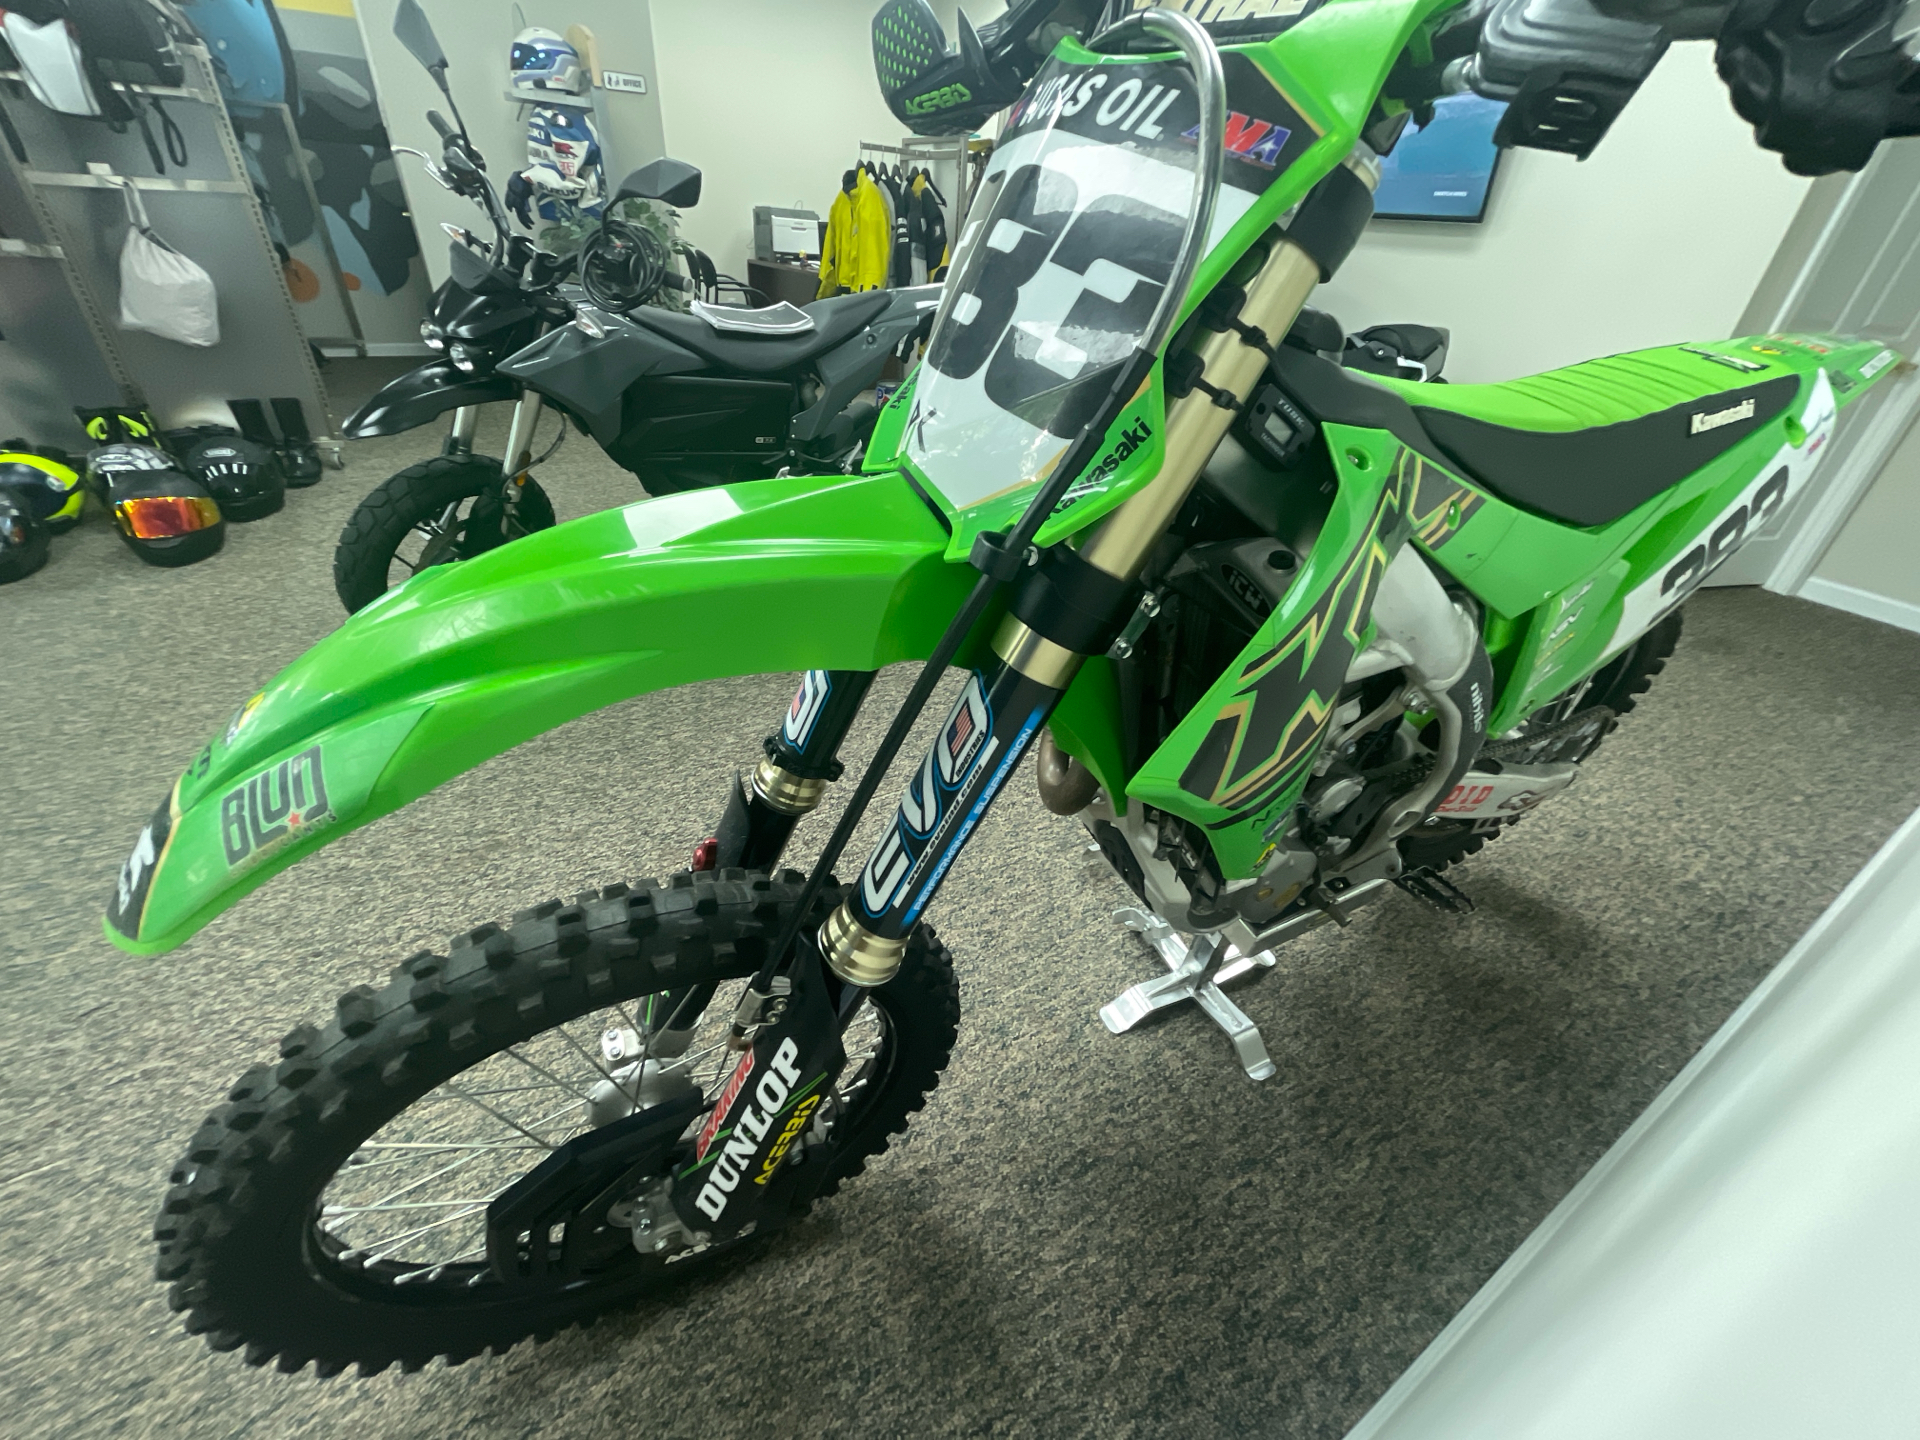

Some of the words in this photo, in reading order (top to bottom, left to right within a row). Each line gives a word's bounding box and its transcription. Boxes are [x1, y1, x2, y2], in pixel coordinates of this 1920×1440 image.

[622, 78, 642, 88] OFFICE
[1096, 78, 1181, 140] OIL
[1278, 397, 1304, 427] TUSK
[1043, 416, 1152, 522] awasaki
[955, 729, 986, 778] INDUSTRIES
[913, 819, 974, 912] PERFORMANCE
[973, 727, 1033, 816] SUSPENSION
[1442, 785, 1494, 805] DID
[695, 1036, 801, 1222] DUNLOP
[753, 1094, 821, 1185] ACERBIS
